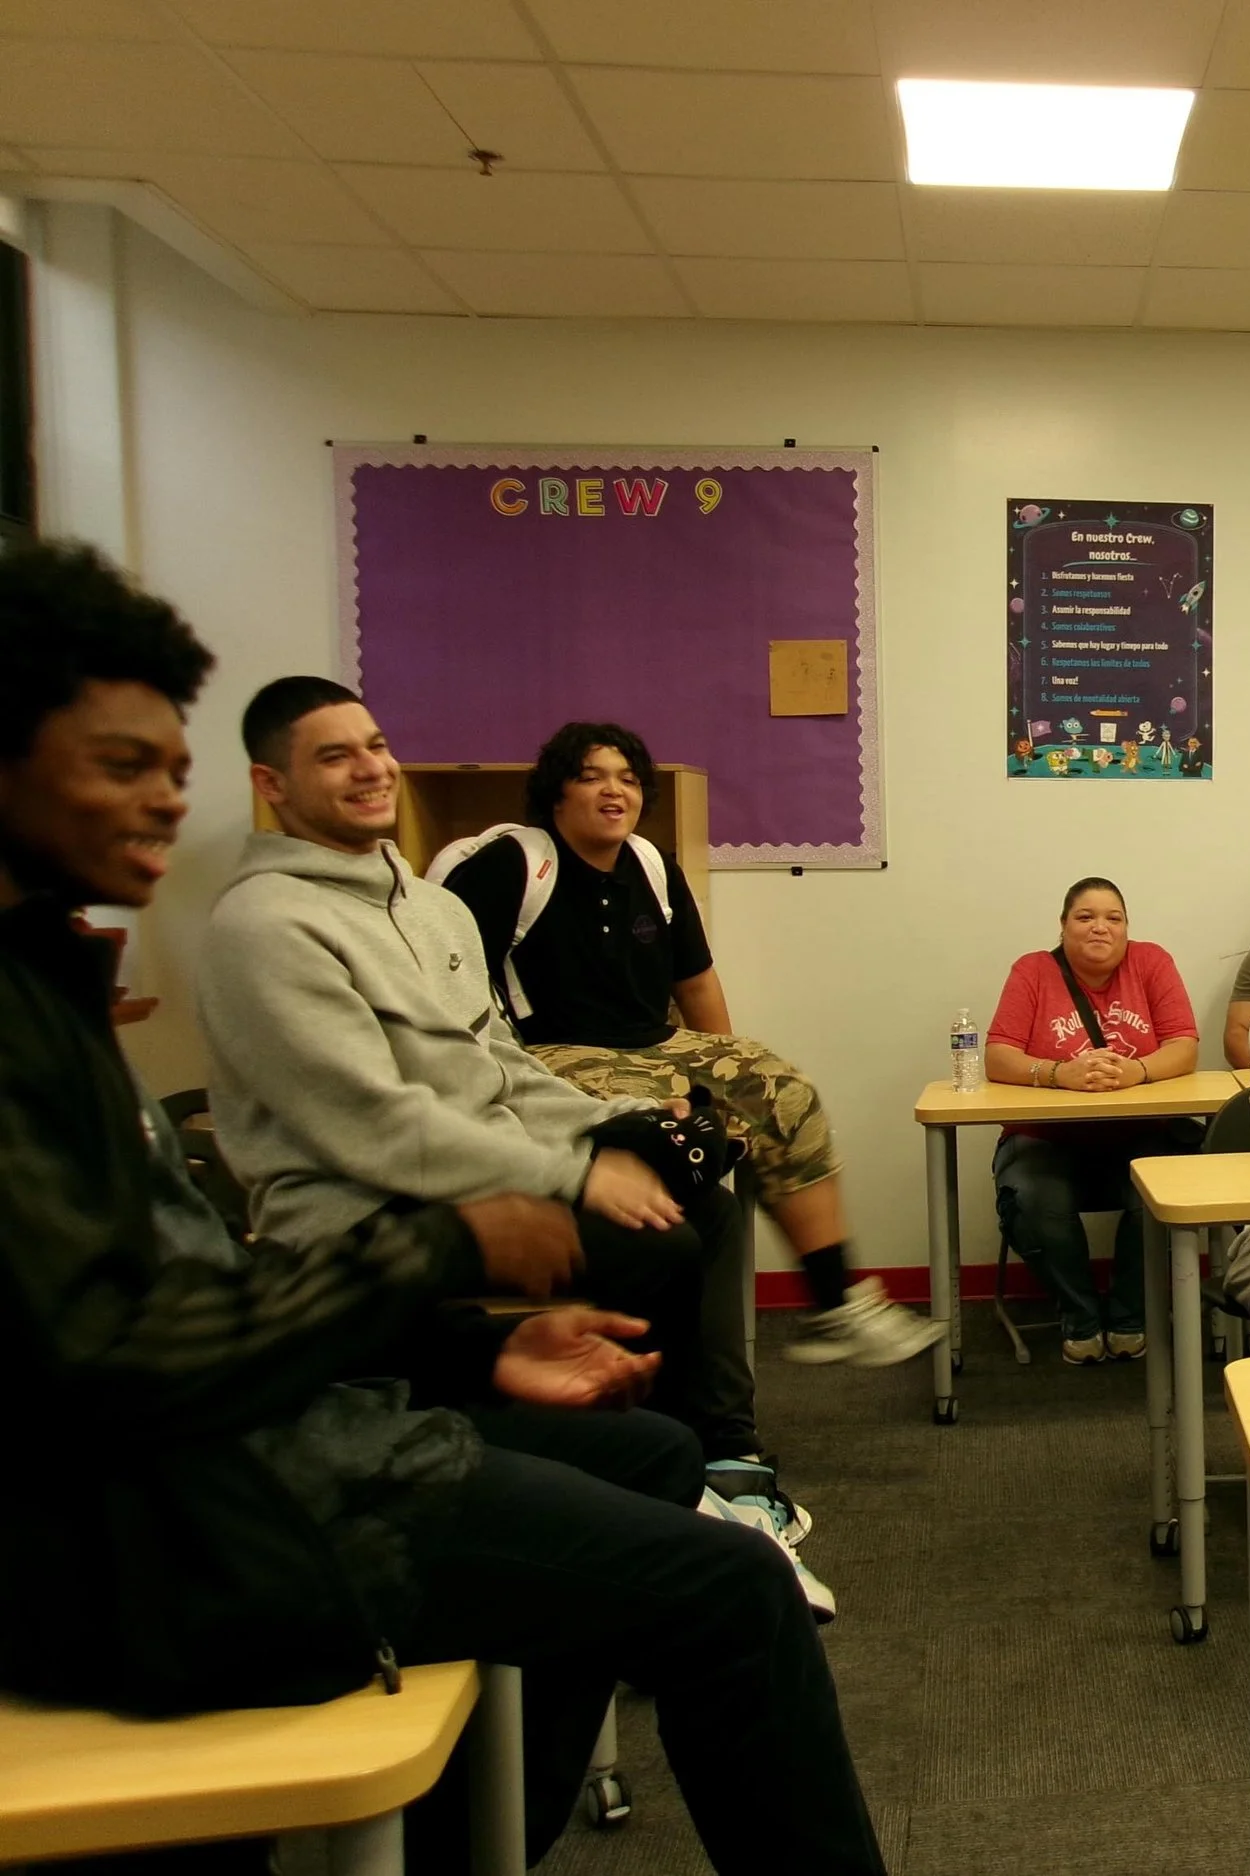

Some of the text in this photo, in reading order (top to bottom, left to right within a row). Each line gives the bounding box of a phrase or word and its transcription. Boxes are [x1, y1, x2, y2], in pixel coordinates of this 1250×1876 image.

[491, 478, 722, 516] CREW 9
[1072, 532, 1083, 542] En
[1086, 533, 1124, 543] nuestro
[1052, 572, 1086, 580] Disfrutamos
[1117, 573, 1134, 581] fiesta
[1052, 606, 1074, 614] Asumir
[1075, 606, 1081, 614] la
[1082, 606, 1131, 616] responsabilidad
[1052, 640, 1077, 648] Sabemos
[1090, 641, 1100, 650] hay
[1101, 641, 1115, 651] lugar
[1116, 643, 1120, 651] y
[1052, 676, 1064, 685] Una
